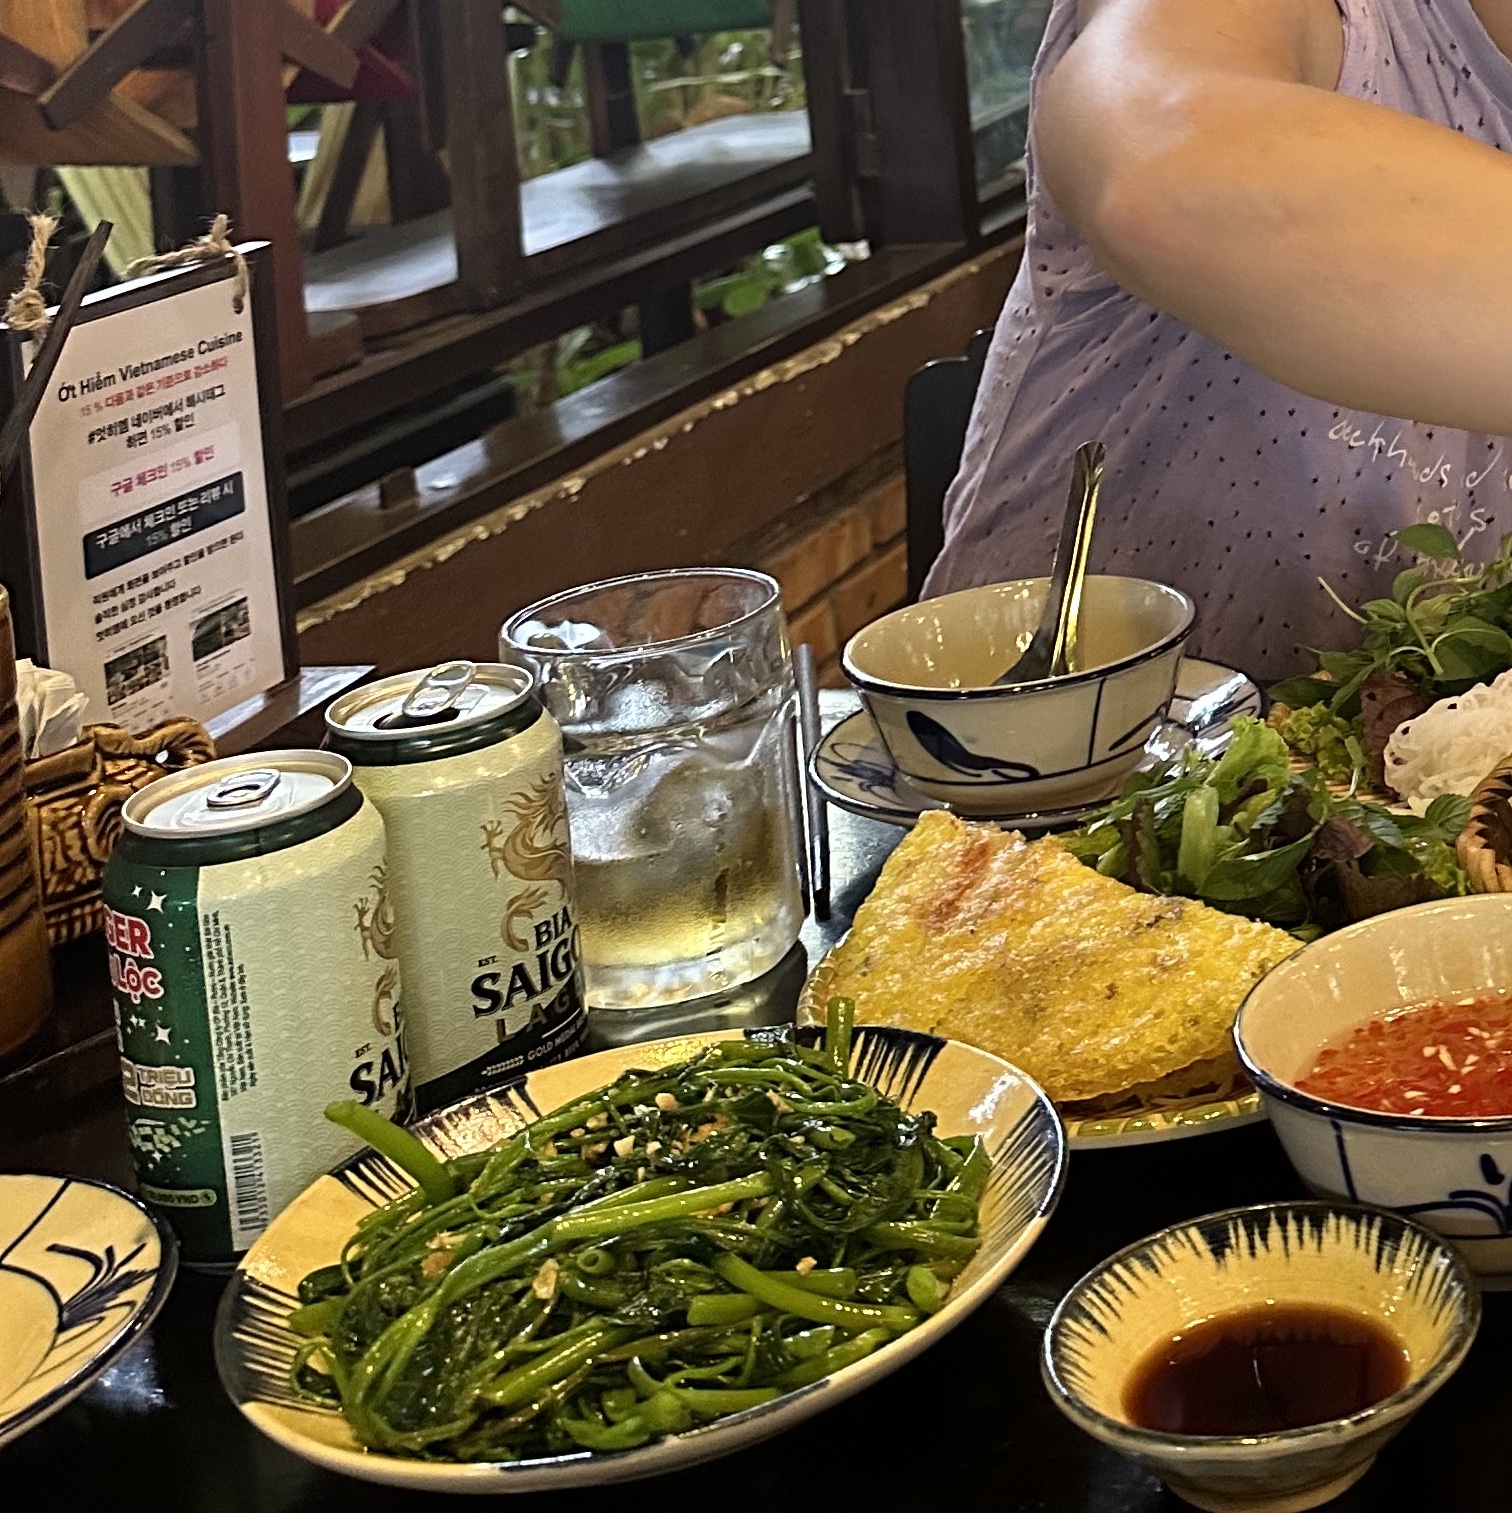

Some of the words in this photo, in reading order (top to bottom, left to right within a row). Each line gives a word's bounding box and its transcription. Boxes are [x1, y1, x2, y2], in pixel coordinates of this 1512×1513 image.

[118, 347, 195, 382] Vietnamese
[197, 331, 243, 355] Cuisine
[534, 905, 572, 951] BIA
[527, 1041, 553, 1061] GOLD
